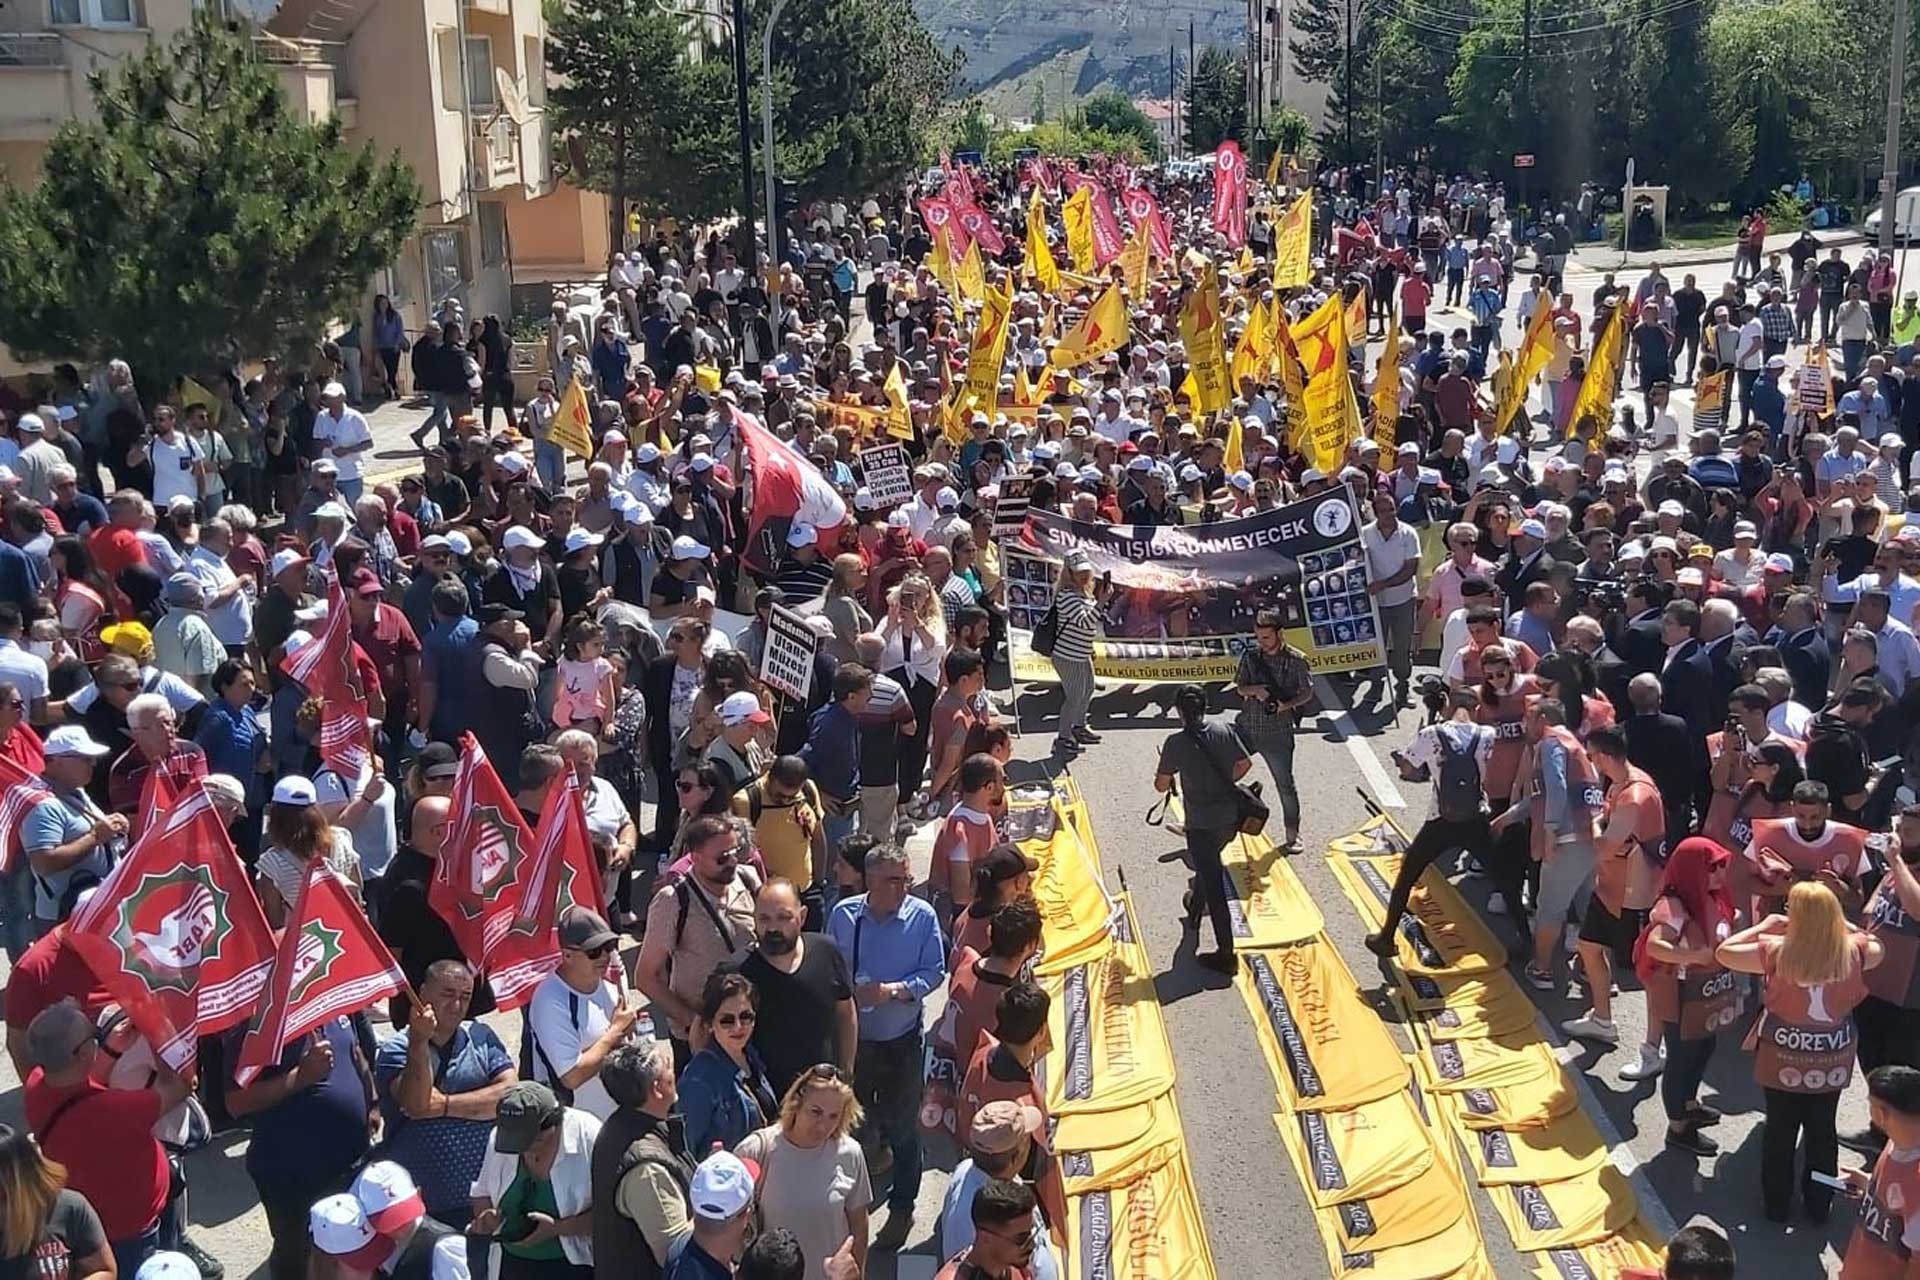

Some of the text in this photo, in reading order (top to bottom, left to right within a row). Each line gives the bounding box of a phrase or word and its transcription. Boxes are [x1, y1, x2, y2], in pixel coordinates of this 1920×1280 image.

[768, 646, 808, 678] Müzesi
[1118, 666, 1159, 678] KÜLTÜR
[1162, 665, 1208, 678] DERNEĞİ
[1774, 1024, 1851, 1052] GÖREVLİ
